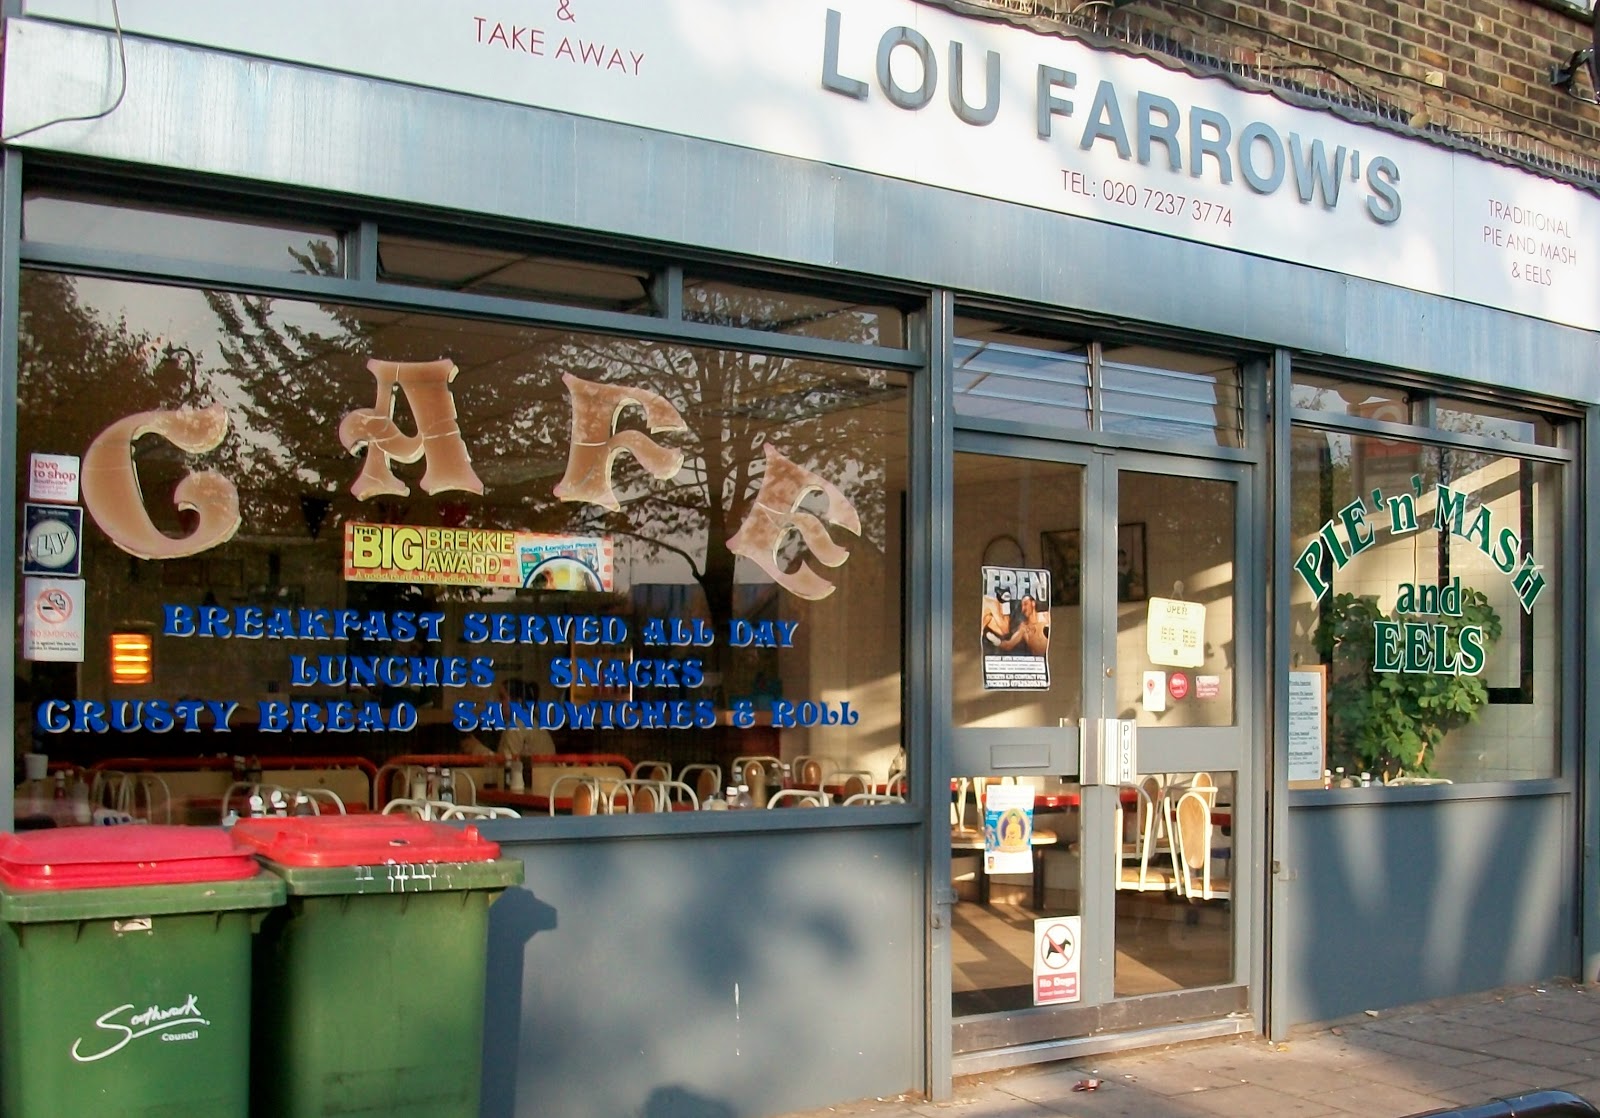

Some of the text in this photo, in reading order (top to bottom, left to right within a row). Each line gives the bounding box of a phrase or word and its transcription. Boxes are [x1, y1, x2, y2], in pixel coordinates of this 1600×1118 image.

[556, 0, 576, 23] &
[474, 16, 644, 76] TAKE AWAY
[821, 8, 1402, 225] LOU FARROW'S
[1061, 169, 1232, 227] TEL: 020 7237 3774
[1488, 199, 1571, 238] TRADITIONAL
[1483, 225, 1577, 265] PIE AND MASH
[1511, 261, 1552, 287] & EELS
[33, 469, 77, 482] to shop
[34, 459, 58, 470] love
[352, 525, 515, 573] THE BIG BREKKIE
[423, 551, 502, 575] AWARD
[521, 545, 544, 553] South
[545, 543, 574, 551] London
[1293, 496, 1376, 602] PIE
[1434, 483, 1547, 614] MASH
[1396, 576, 1463, 616] and
[161, 603, 799, 648] BREAKFAST SERVED ALL DAY
[1373, 621, 1486, 676] EELS
[289, 655, 705, 688] LUNCHES SNACKS
[36, 698, 860, 734] CRUSTY BREAD SANDWICHES & ROLL
[1122, 724, 1130, 780] PUSH
[1039, 976, 1076, 988] No Dogs
[72, 994, 202, 1061] Southwark
[161, 1030, 199, 1041] Council
